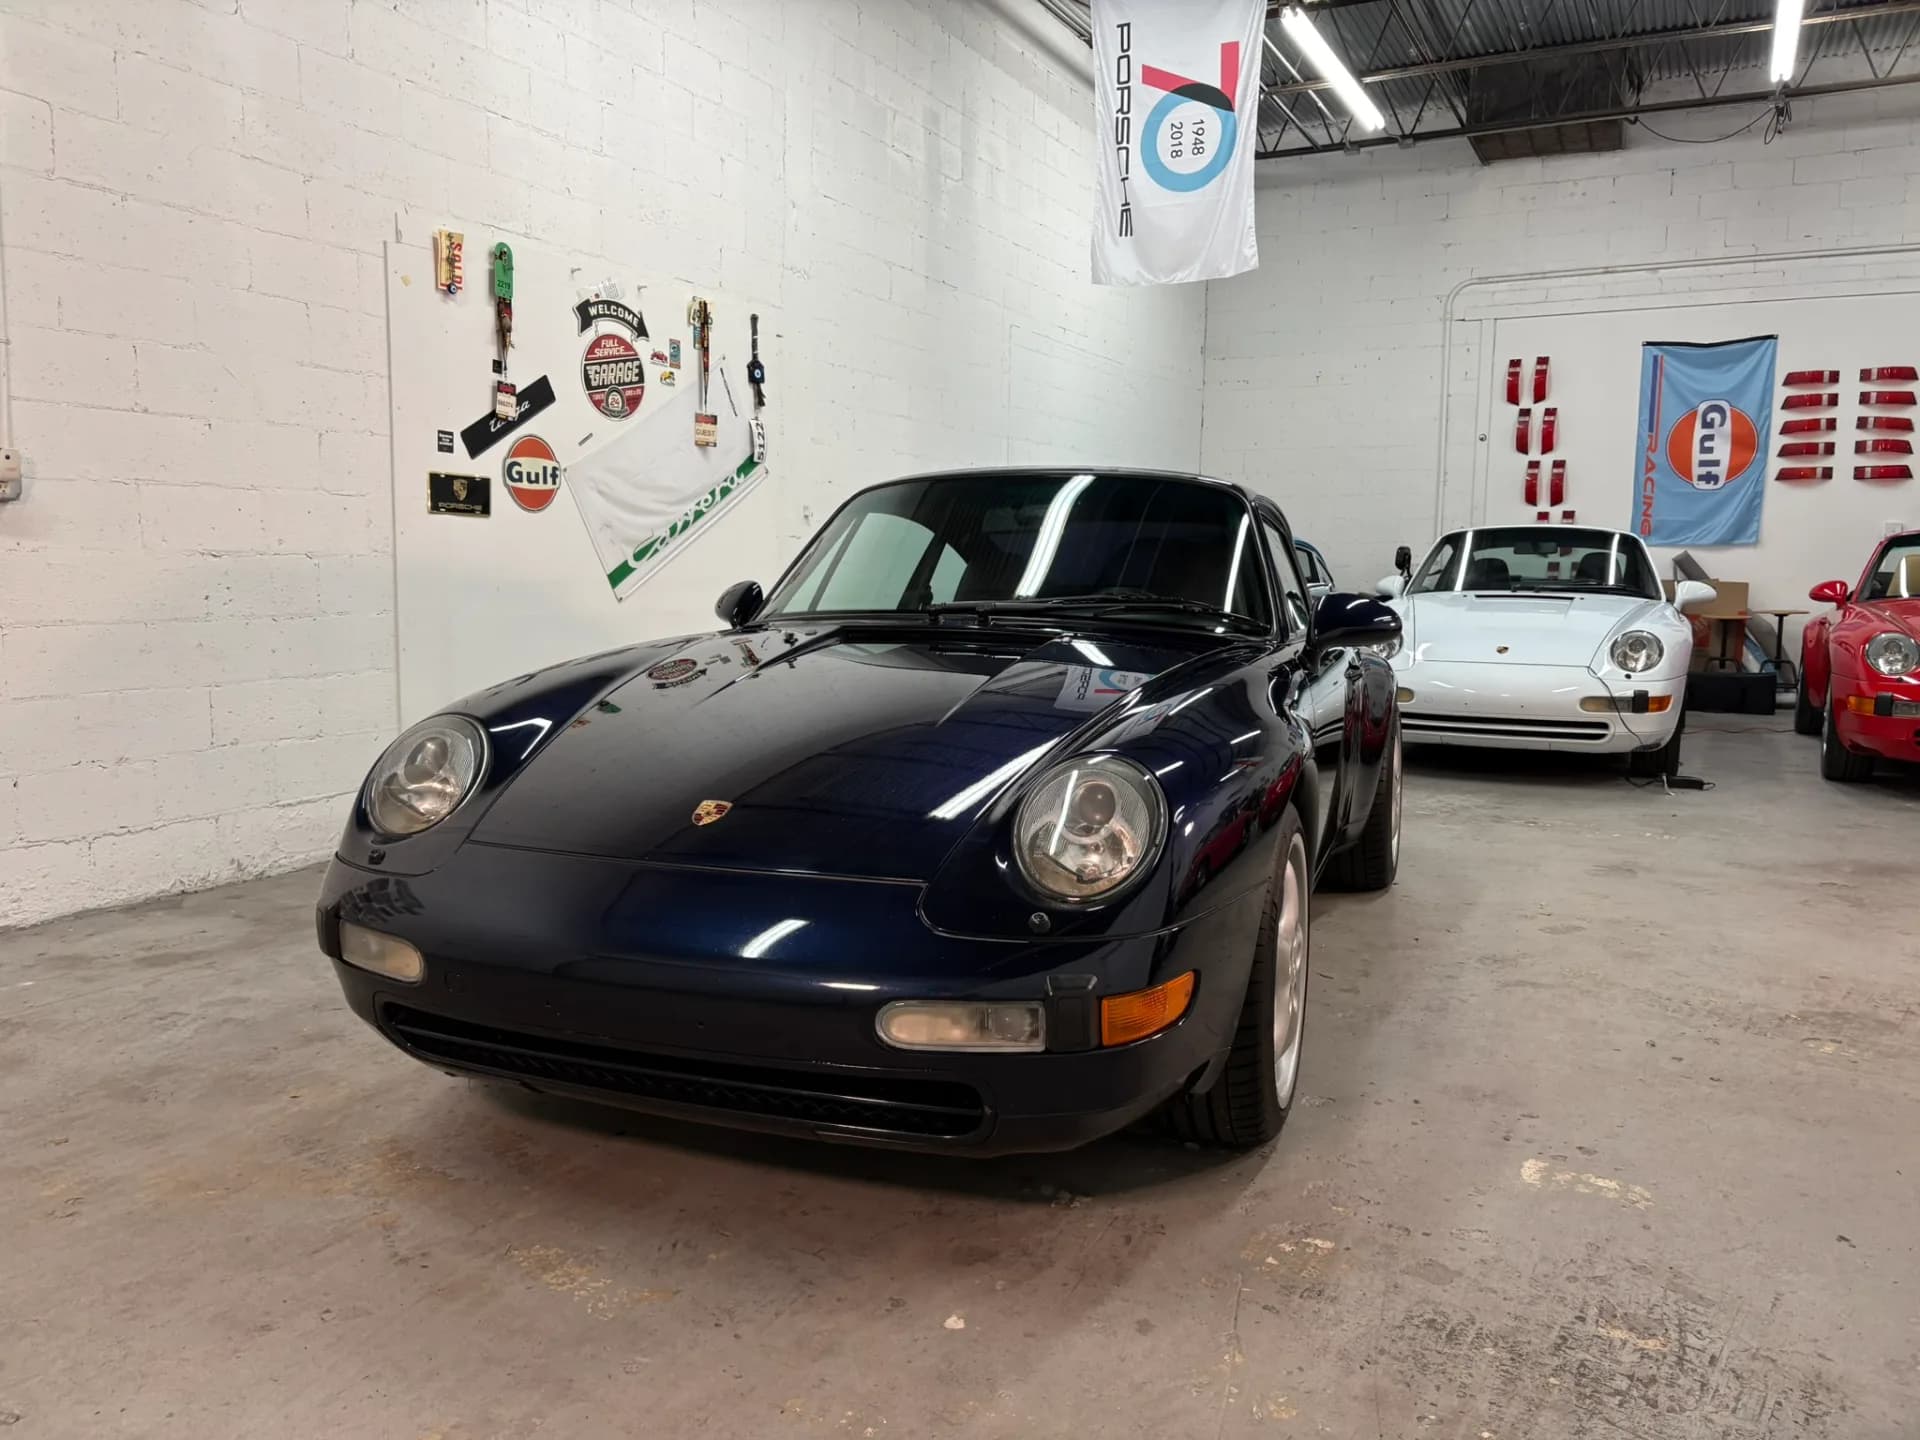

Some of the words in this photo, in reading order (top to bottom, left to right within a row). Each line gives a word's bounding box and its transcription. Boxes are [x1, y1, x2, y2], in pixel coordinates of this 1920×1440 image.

[1115, 22, 1133, 238] PORSCHE
[1170, 121, 1184, 159] 2018
[1191, 119, 1205, 156] 1948
[588, 304, 640, 328] WELCOME
[594, 346, 625, 357] SERVICE
[601, 339, 619, 348] FULL
[588, 361, 640, 387] GARAGE
[610, 397, 620, 406] 24
[754, 422, 765, 461] 5122
[1696, 404, 1727, 486] Gulf
[506, 461, 559, 485] Gulf
[1640, 432, 1659, 537] RACING
[626, 471, 745, 569] Carrera
